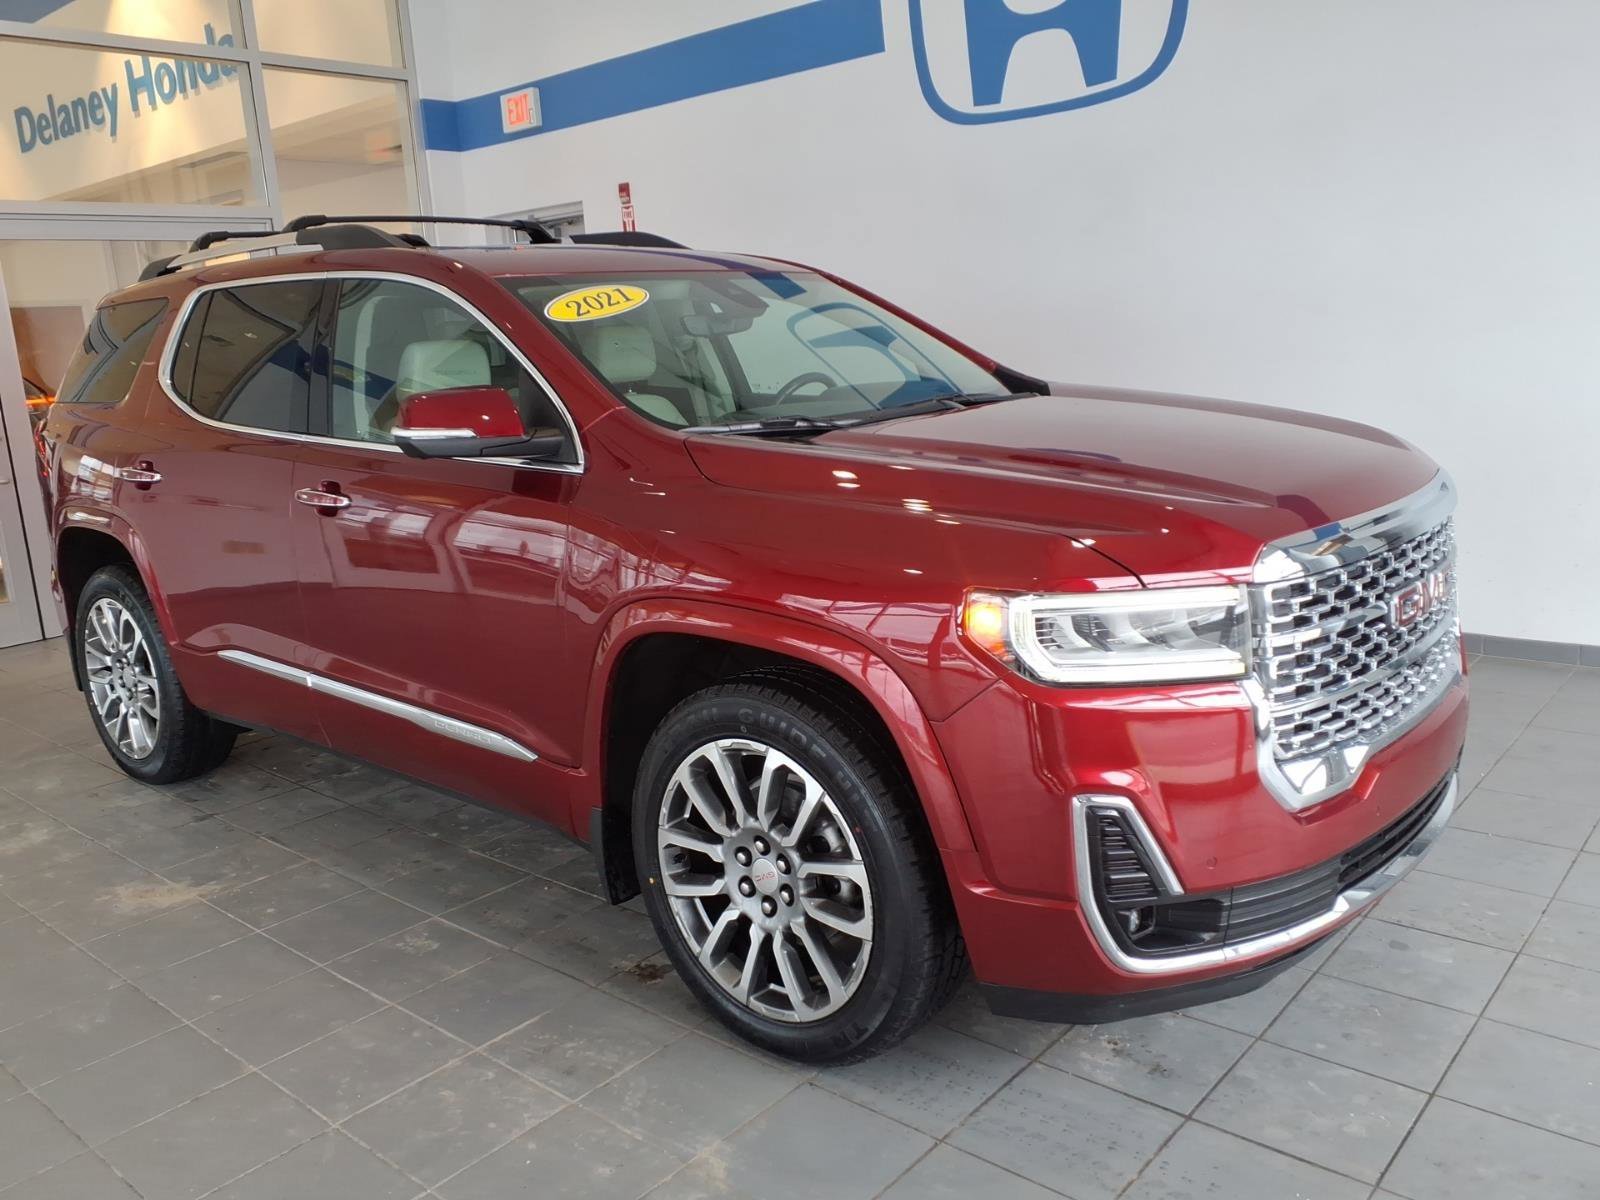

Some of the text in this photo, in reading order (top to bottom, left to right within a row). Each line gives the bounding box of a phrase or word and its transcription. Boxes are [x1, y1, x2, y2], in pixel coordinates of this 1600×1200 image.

[14, 23, 238, 153] Delaney Honda
[507, 93, 529, 126] EXIT
[566, 288, 634, 317] 2021
